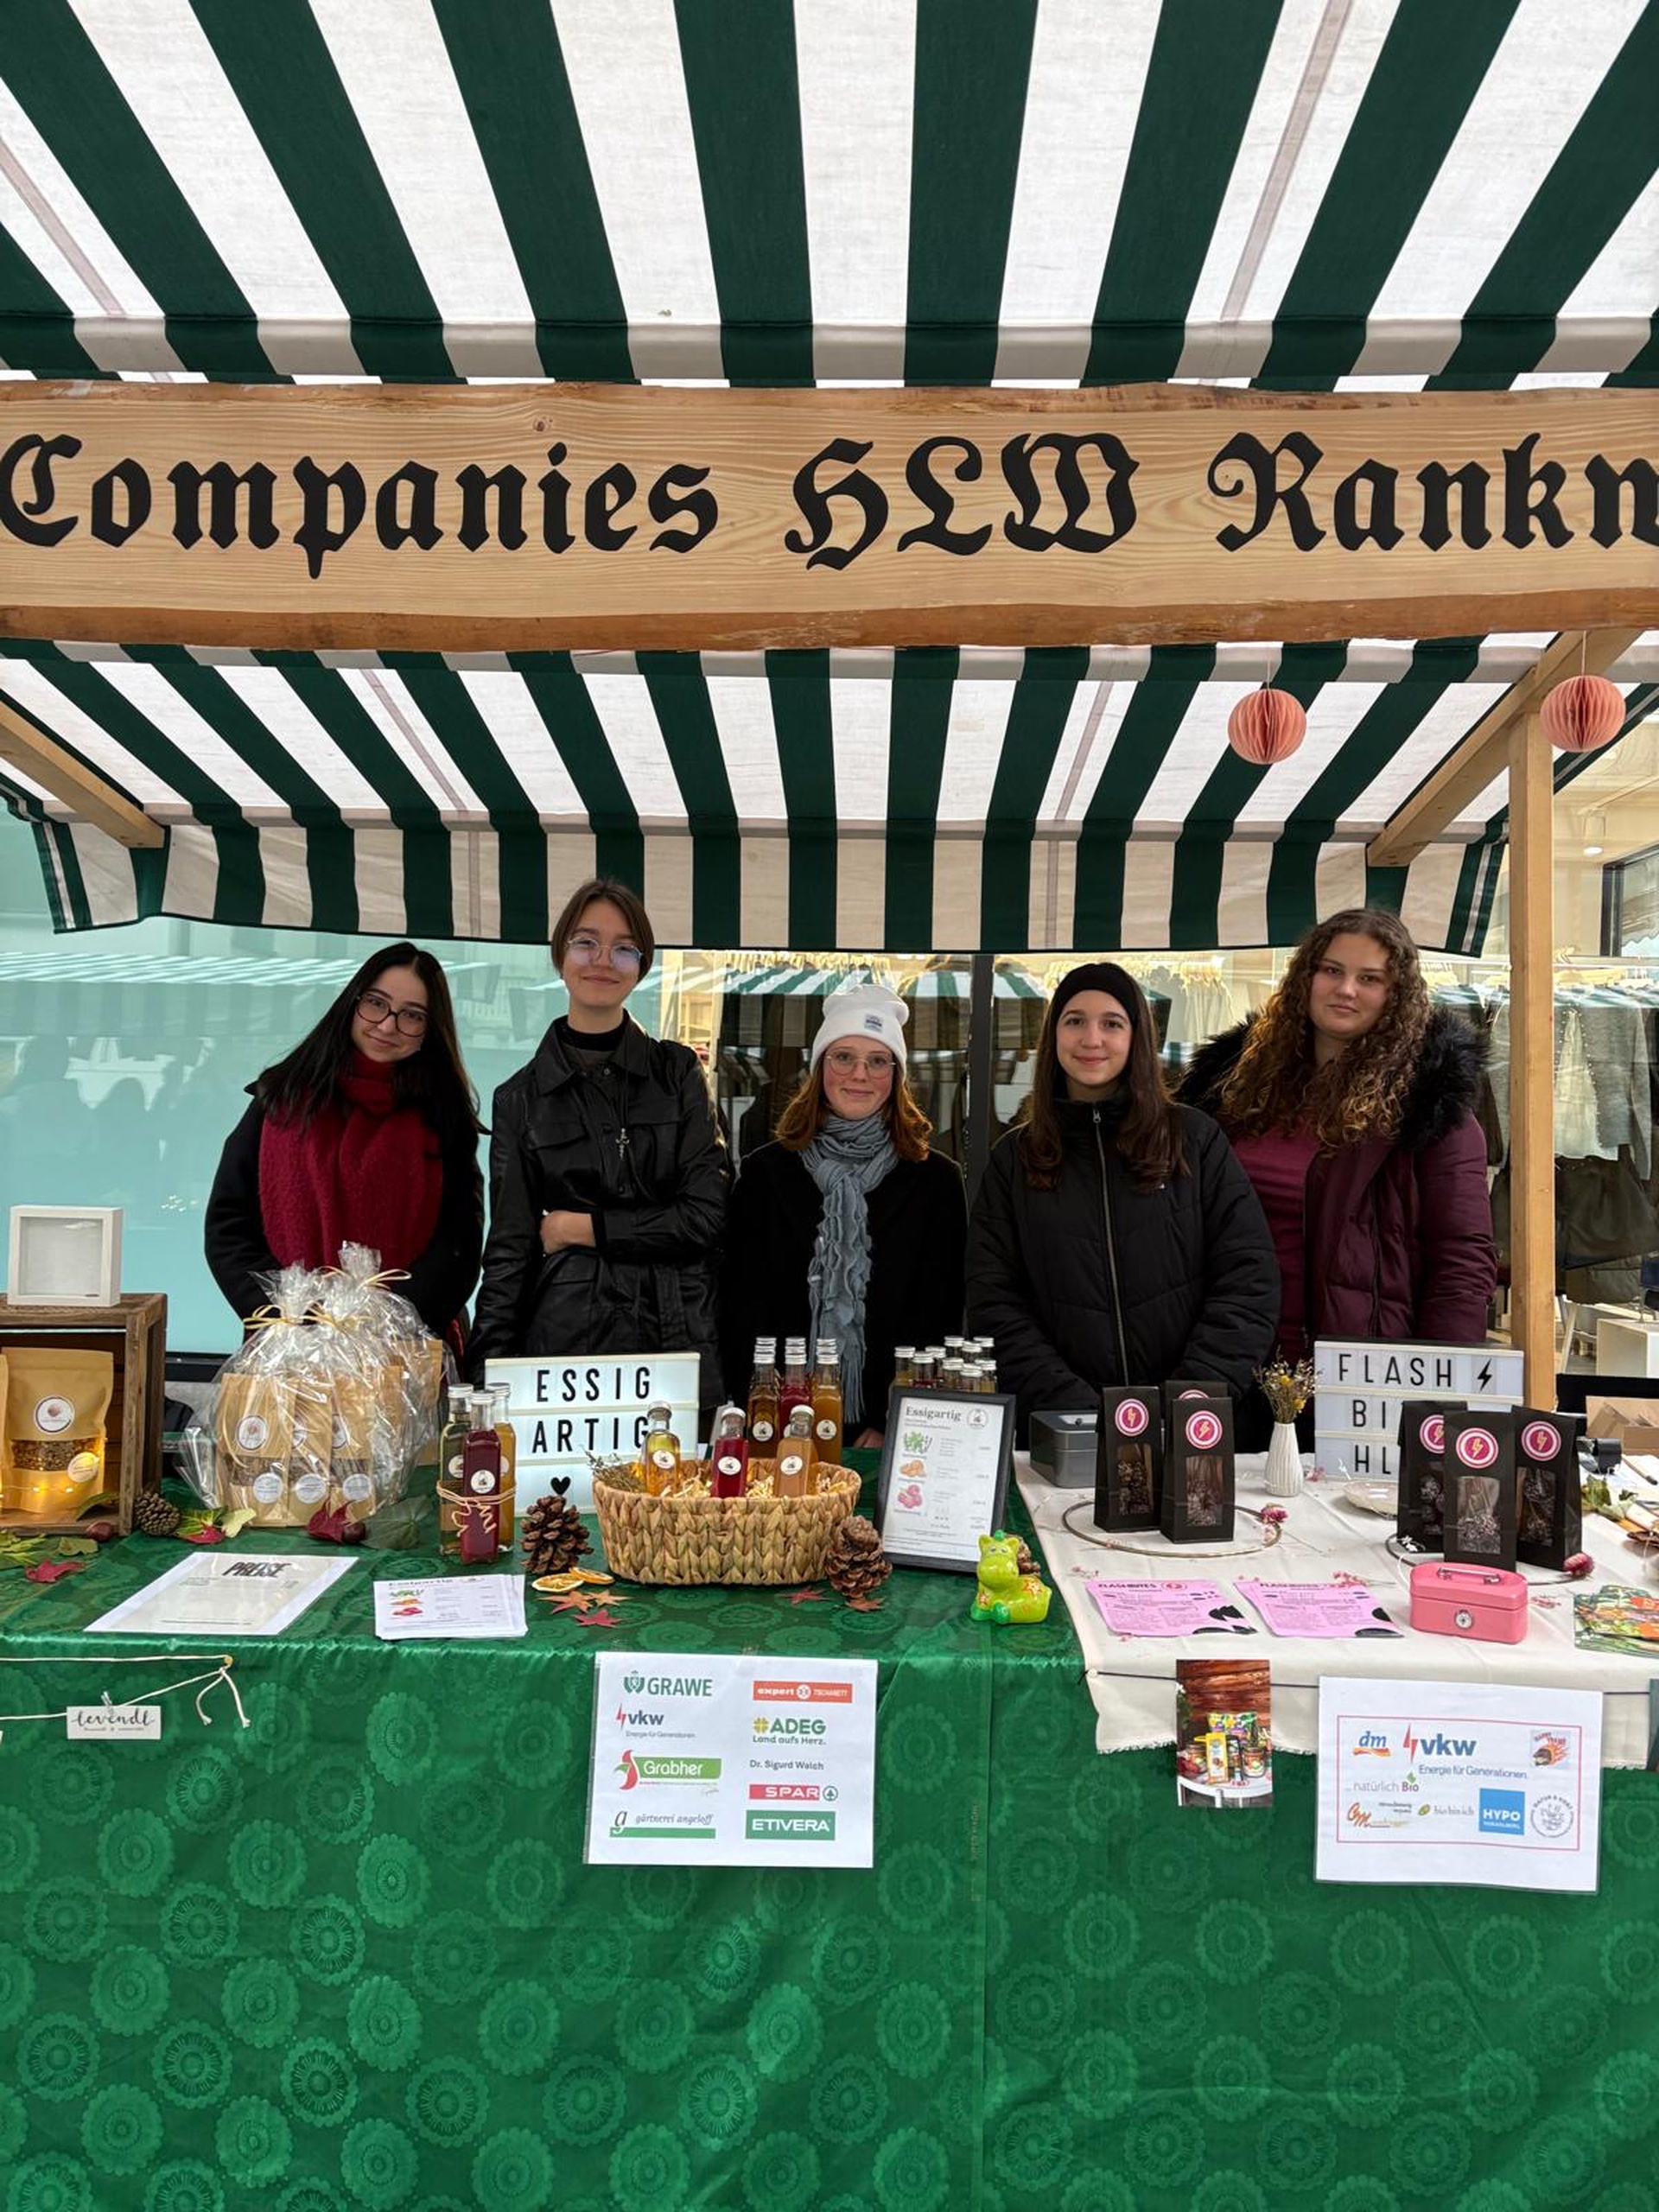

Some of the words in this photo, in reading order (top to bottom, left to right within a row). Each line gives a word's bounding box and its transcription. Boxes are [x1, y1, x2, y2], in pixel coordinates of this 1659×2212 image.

[0, 433, 719, 579] Companies
[785, 431, 1140, 570] HLW
[1339, 1354, 1452, 1388] FLASH
[537, 1367, 650, 1402] ESSIG
[906, 1407, 962, 1421] Essigartig
[1353, 1400, 1386, 1429] BI
[532, 1416, 648, 1453] ARTIG
[1355, 1445, 1391, 1474] HL
[647, 1677, 713, 1696] GRAWE
[758, 1688, 794, 1696] expert
[628, 1710, 664, 1726] vkw
[770, 1718, 826, 1735] ADEG
[753, 1735, 777, 1744] Land
[779, 1736, 799, 1745] aufs
[1359, 1731, 1387, 1748] dm
[1420, 1733, 1477, 1756] vkw
[643, 1760, 703, 1776] Grabher
[749, 1759, 762, 1768] Dr.
[765, 1760, 793, 1770] Sigurd
[1419, 1764, 1452, 1776] Energie
[1465, 1765, 1527, 1778] Generationen
[765, 1787, 819, 1798] SPAR
[1402, 1782, 1419, 1792] Bio
[1483, 1808, 1521, 1821] HYPO
[752, 1819, 830, 1832] ETIVERA
